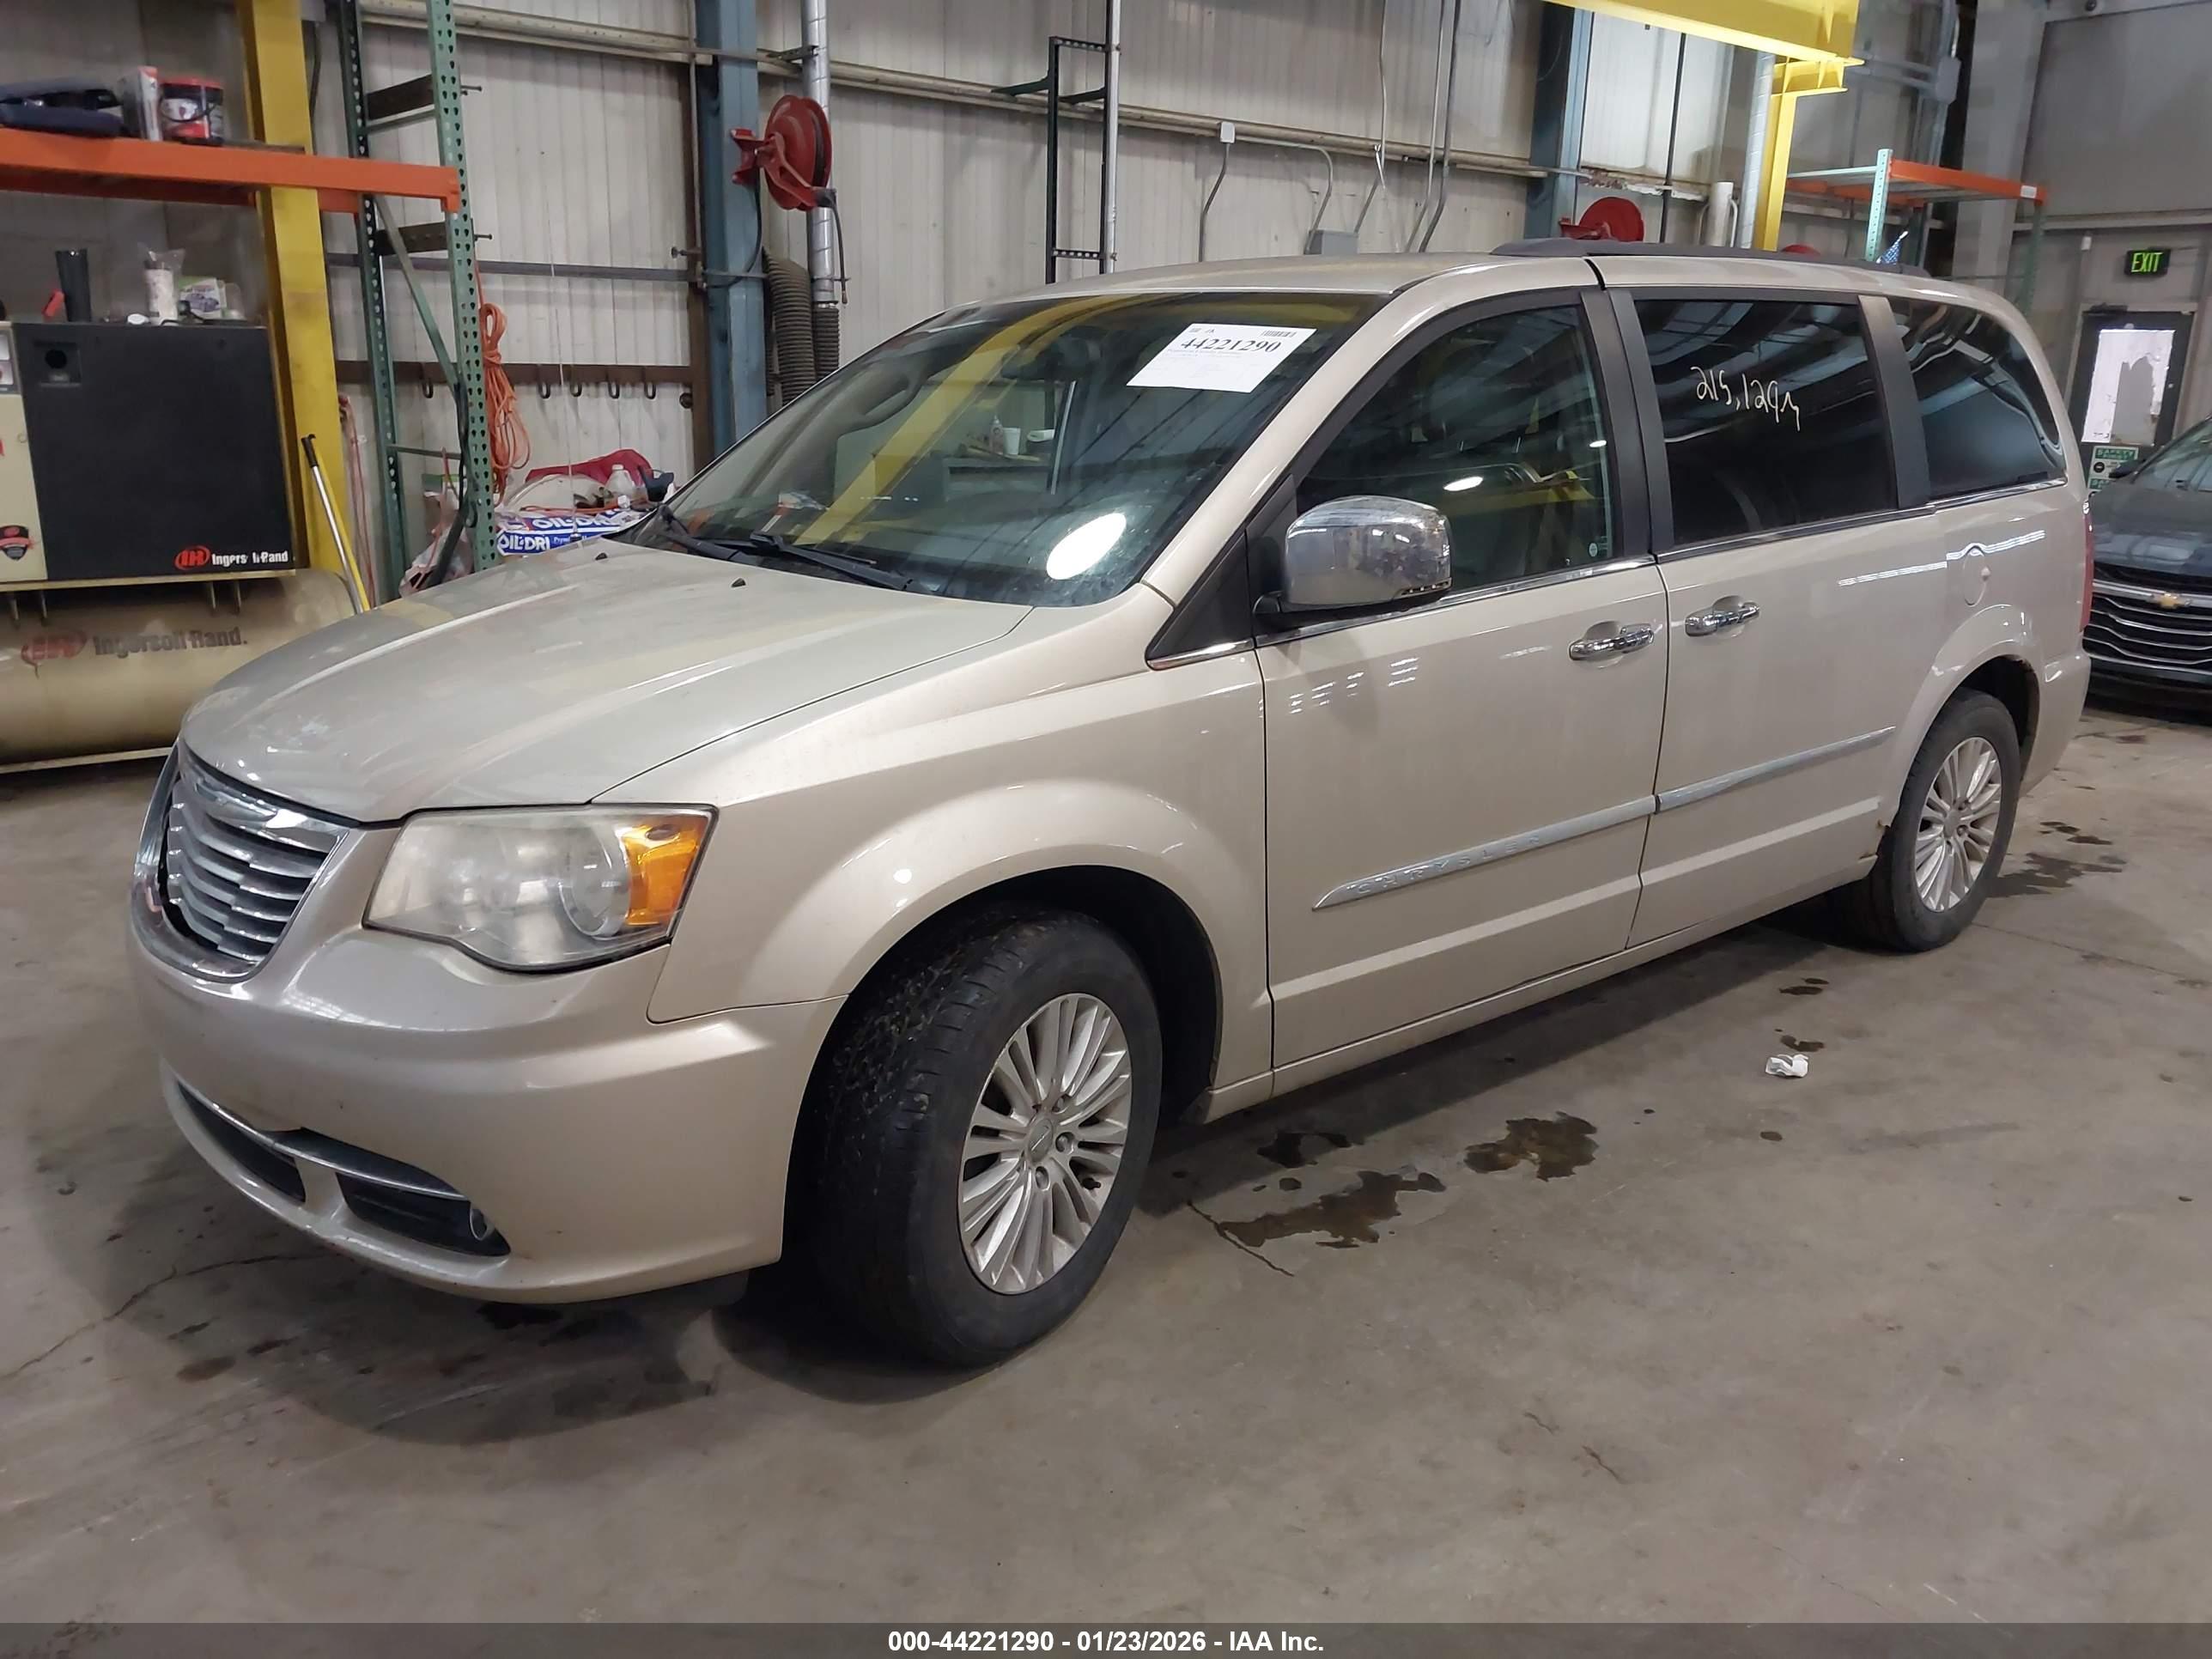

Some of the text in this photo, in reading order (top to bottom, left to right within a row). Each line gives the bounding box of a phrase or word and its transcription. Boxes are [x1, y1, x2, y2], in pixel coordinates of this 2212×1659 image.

[2130, 252, 2164, 273] EXIT
[1181, 337, 1283, 353] 44221290
[1346, 835, 1540, 894] CHRYSLER
